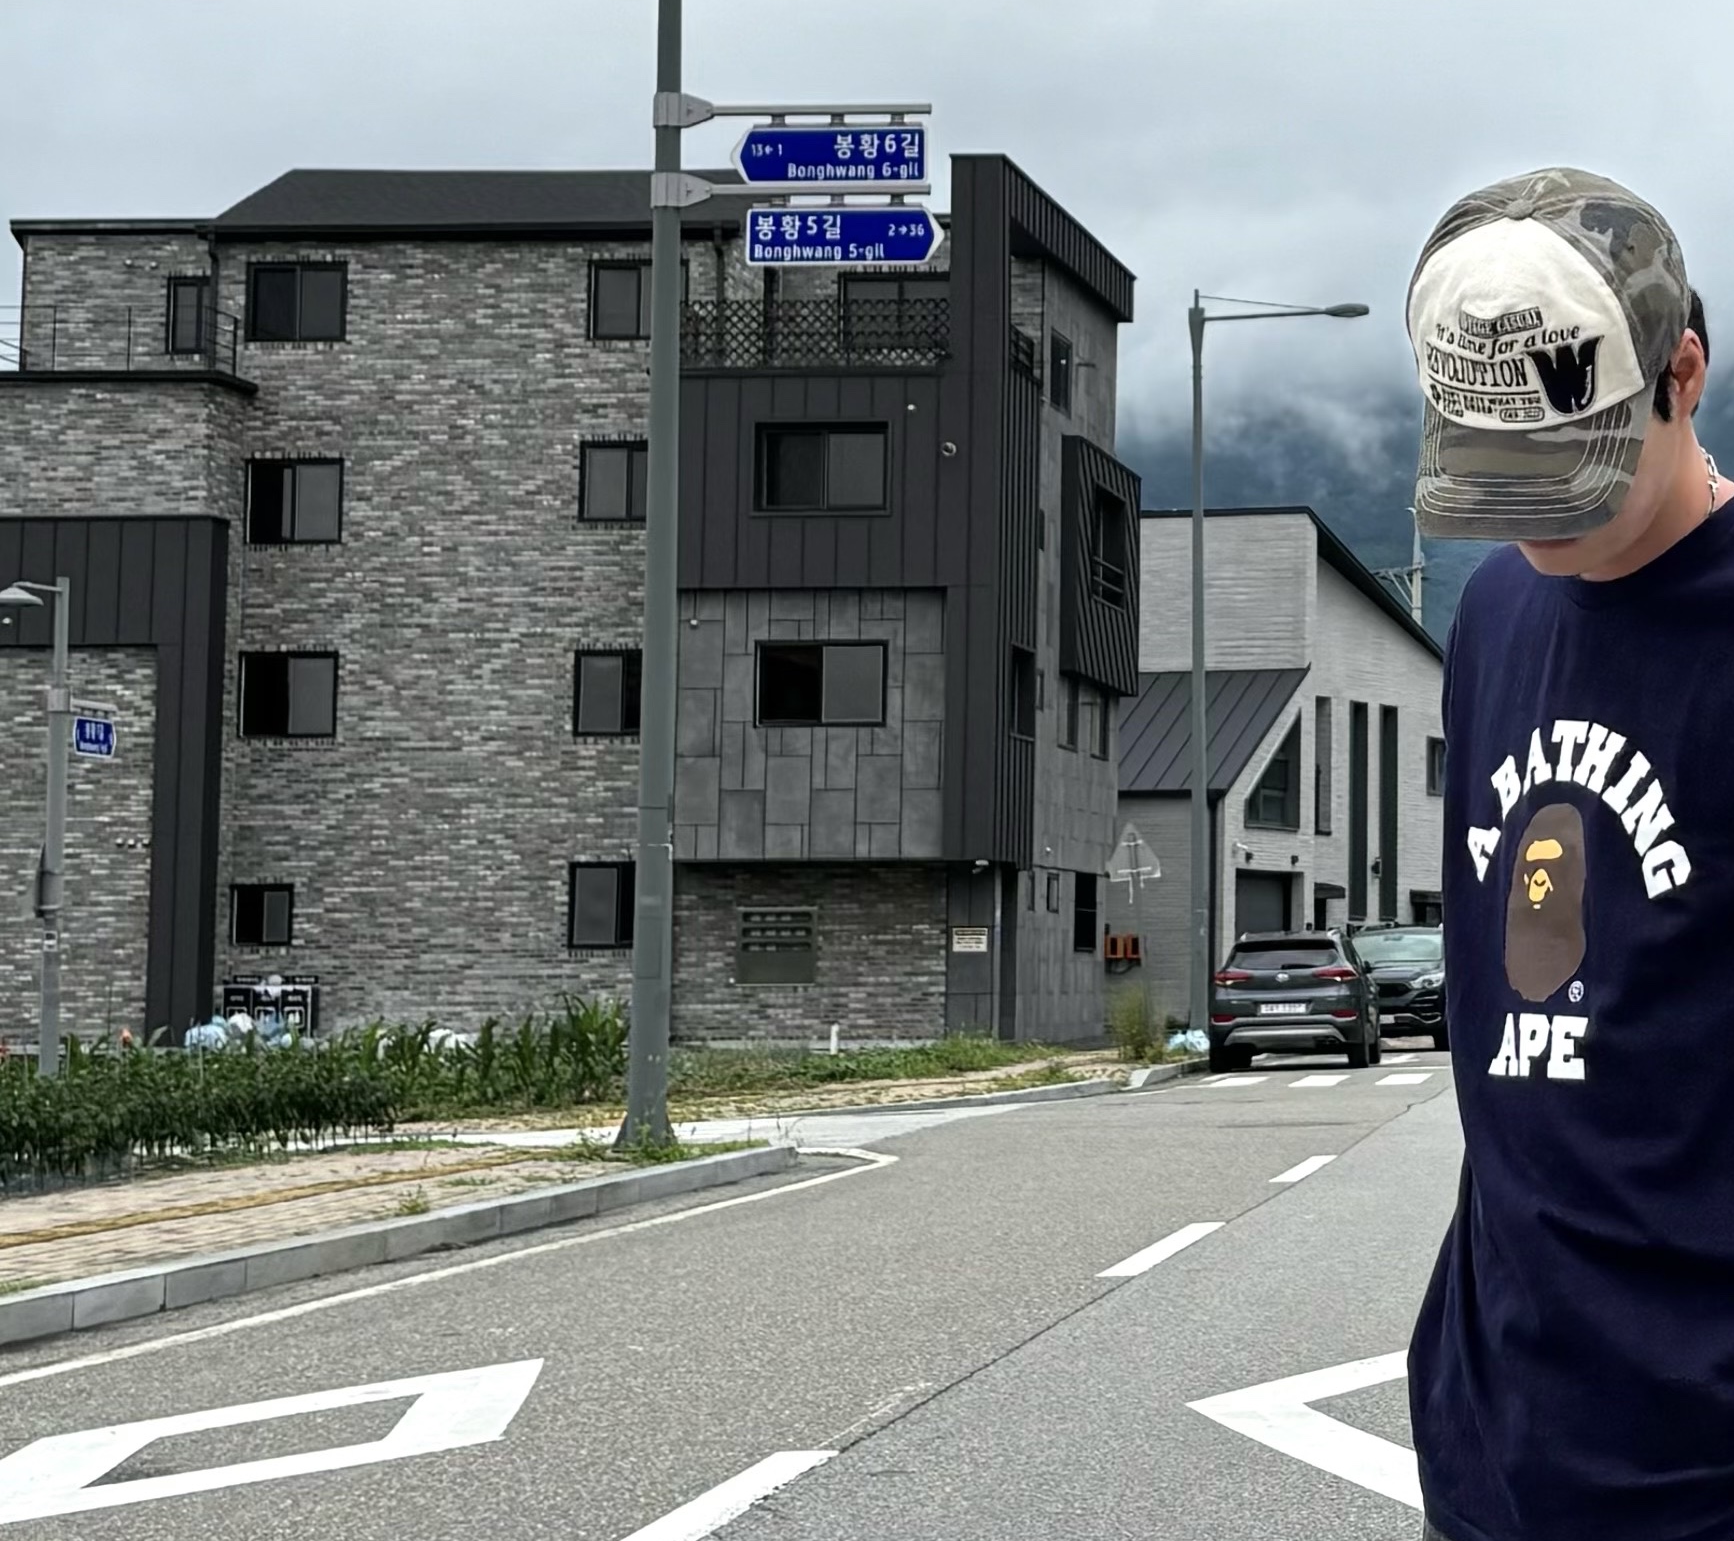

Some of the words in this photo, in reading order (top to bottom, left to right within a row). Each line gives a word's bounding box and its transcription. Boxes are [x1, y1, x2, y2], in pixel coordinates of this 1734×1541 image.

[833, 133, 920, 159] 봉황6길
[787, 162, 876, 181] Bonghwang
[881, 162, 919, 180] 6-gil
[754, 215, 841, 241] 봉황5길
[753, 243, 842, 261] Bonghwang
[848, 243, 885, 260] 5-gil
[1487, 338, 1519, 360] for
[1524, 335, 1537, 349] a
[1541, 326, 1580, 345] love
[1466, 825, 1502, 883] A
[1490, 719, 1692, 899] BATHING
[1488, 1012, 1589, 1080] APE
